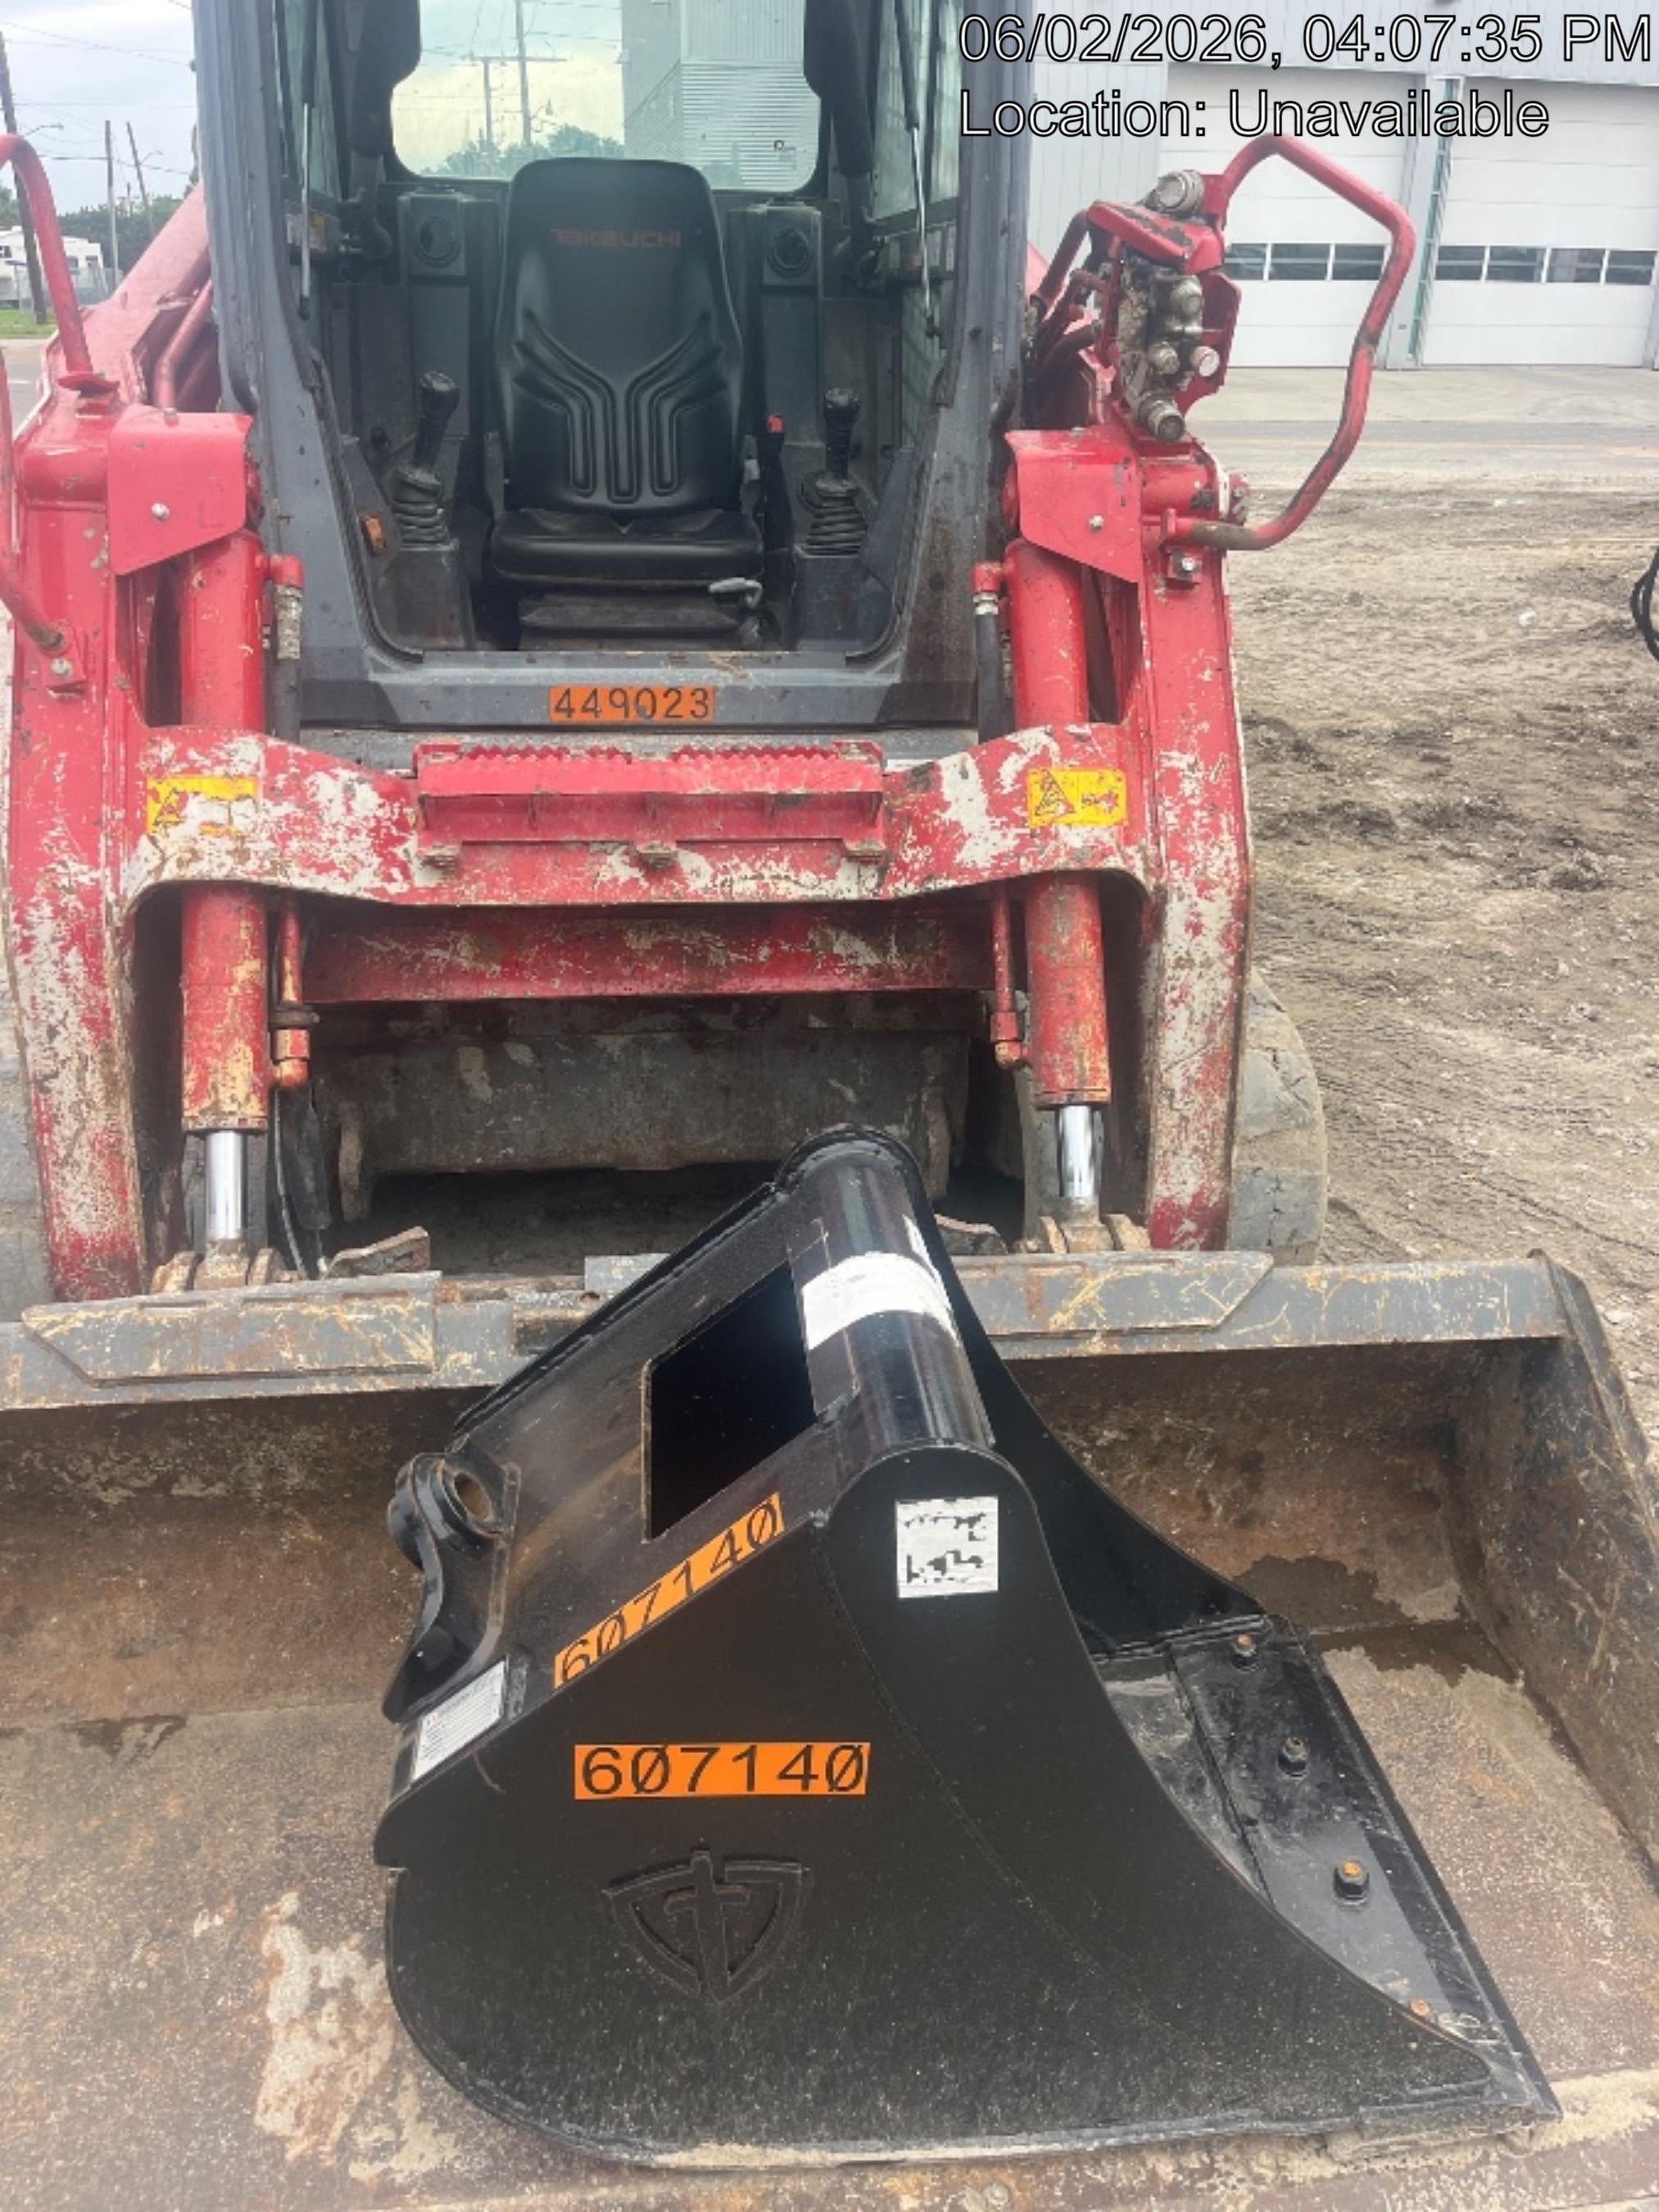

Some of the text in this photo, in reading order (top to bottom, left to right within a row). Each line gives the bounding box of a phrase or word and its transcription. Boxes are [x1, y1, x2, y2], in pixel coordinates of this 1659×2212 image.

[554, 687, 709, 719] 449023
[561, 1498, 779, 1684] 607140
[581, 1743, 864, 1796] 607140
